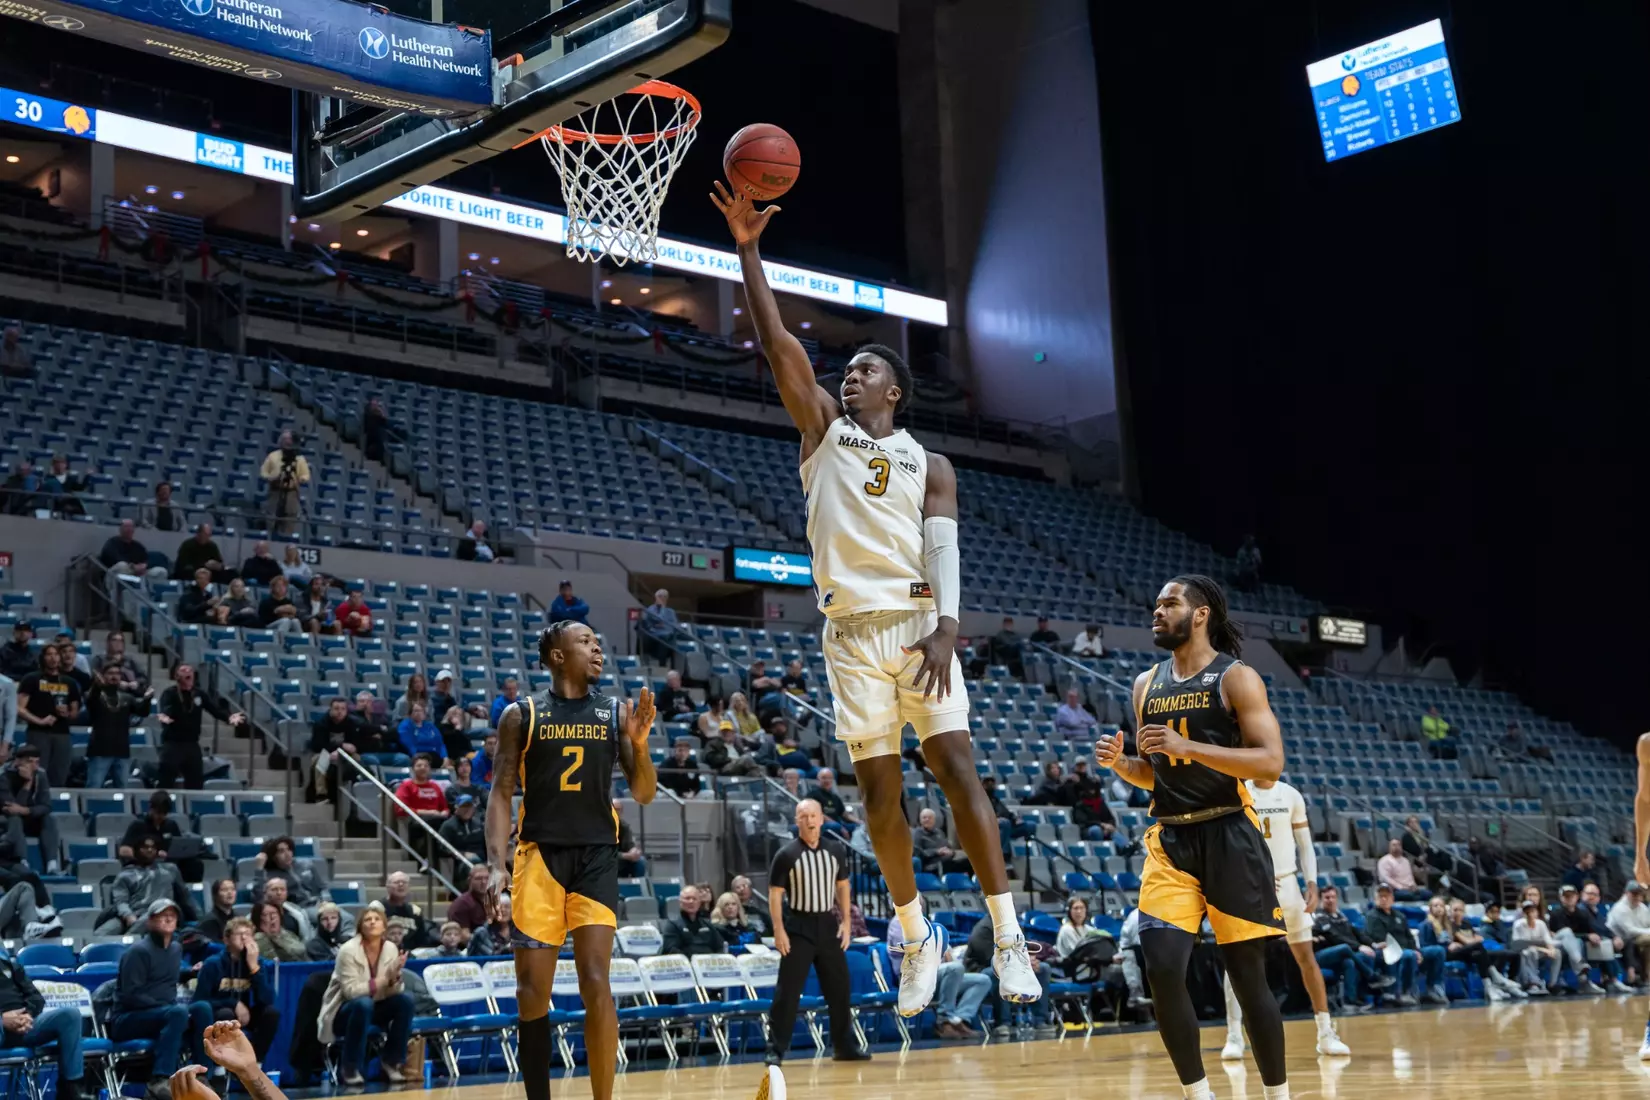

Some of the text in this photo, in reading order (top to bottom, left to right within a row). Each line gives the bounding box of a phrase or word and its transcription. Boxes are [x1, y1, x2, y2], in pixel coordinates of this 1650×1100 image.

[216, 6, 313, 42] Health Network
[391, 33, 453, 57] Lutheran
[168, 51, 242, 72] Lutheran
[392, 50, 482, 77] Health Network
[15, 97, 42, 122] 30
[198, 147, 242, 169] LIGHT
[204, 137, 236, 156] BUD
[263, 155, 293, 176] THE
[459, 200, 502, 222] LIGHT
[507, 211, 544, 230] BEER
[659, 245, 705, 266] ORLD'S
[772, 270, 805, 287] LIGHT
[810, 277, 839, 294] BEER
[864, 457, 891, 496] 3
[299, 548, 318, 563] 15
[664, 552, 682, 565] 217
[1147, 691, 1211, 715] COMMERCE
[540, 724, 608, 741] COMMERCE
[560, 746, 585, 791] 2
[1263, 817, 1272, 838] 1
